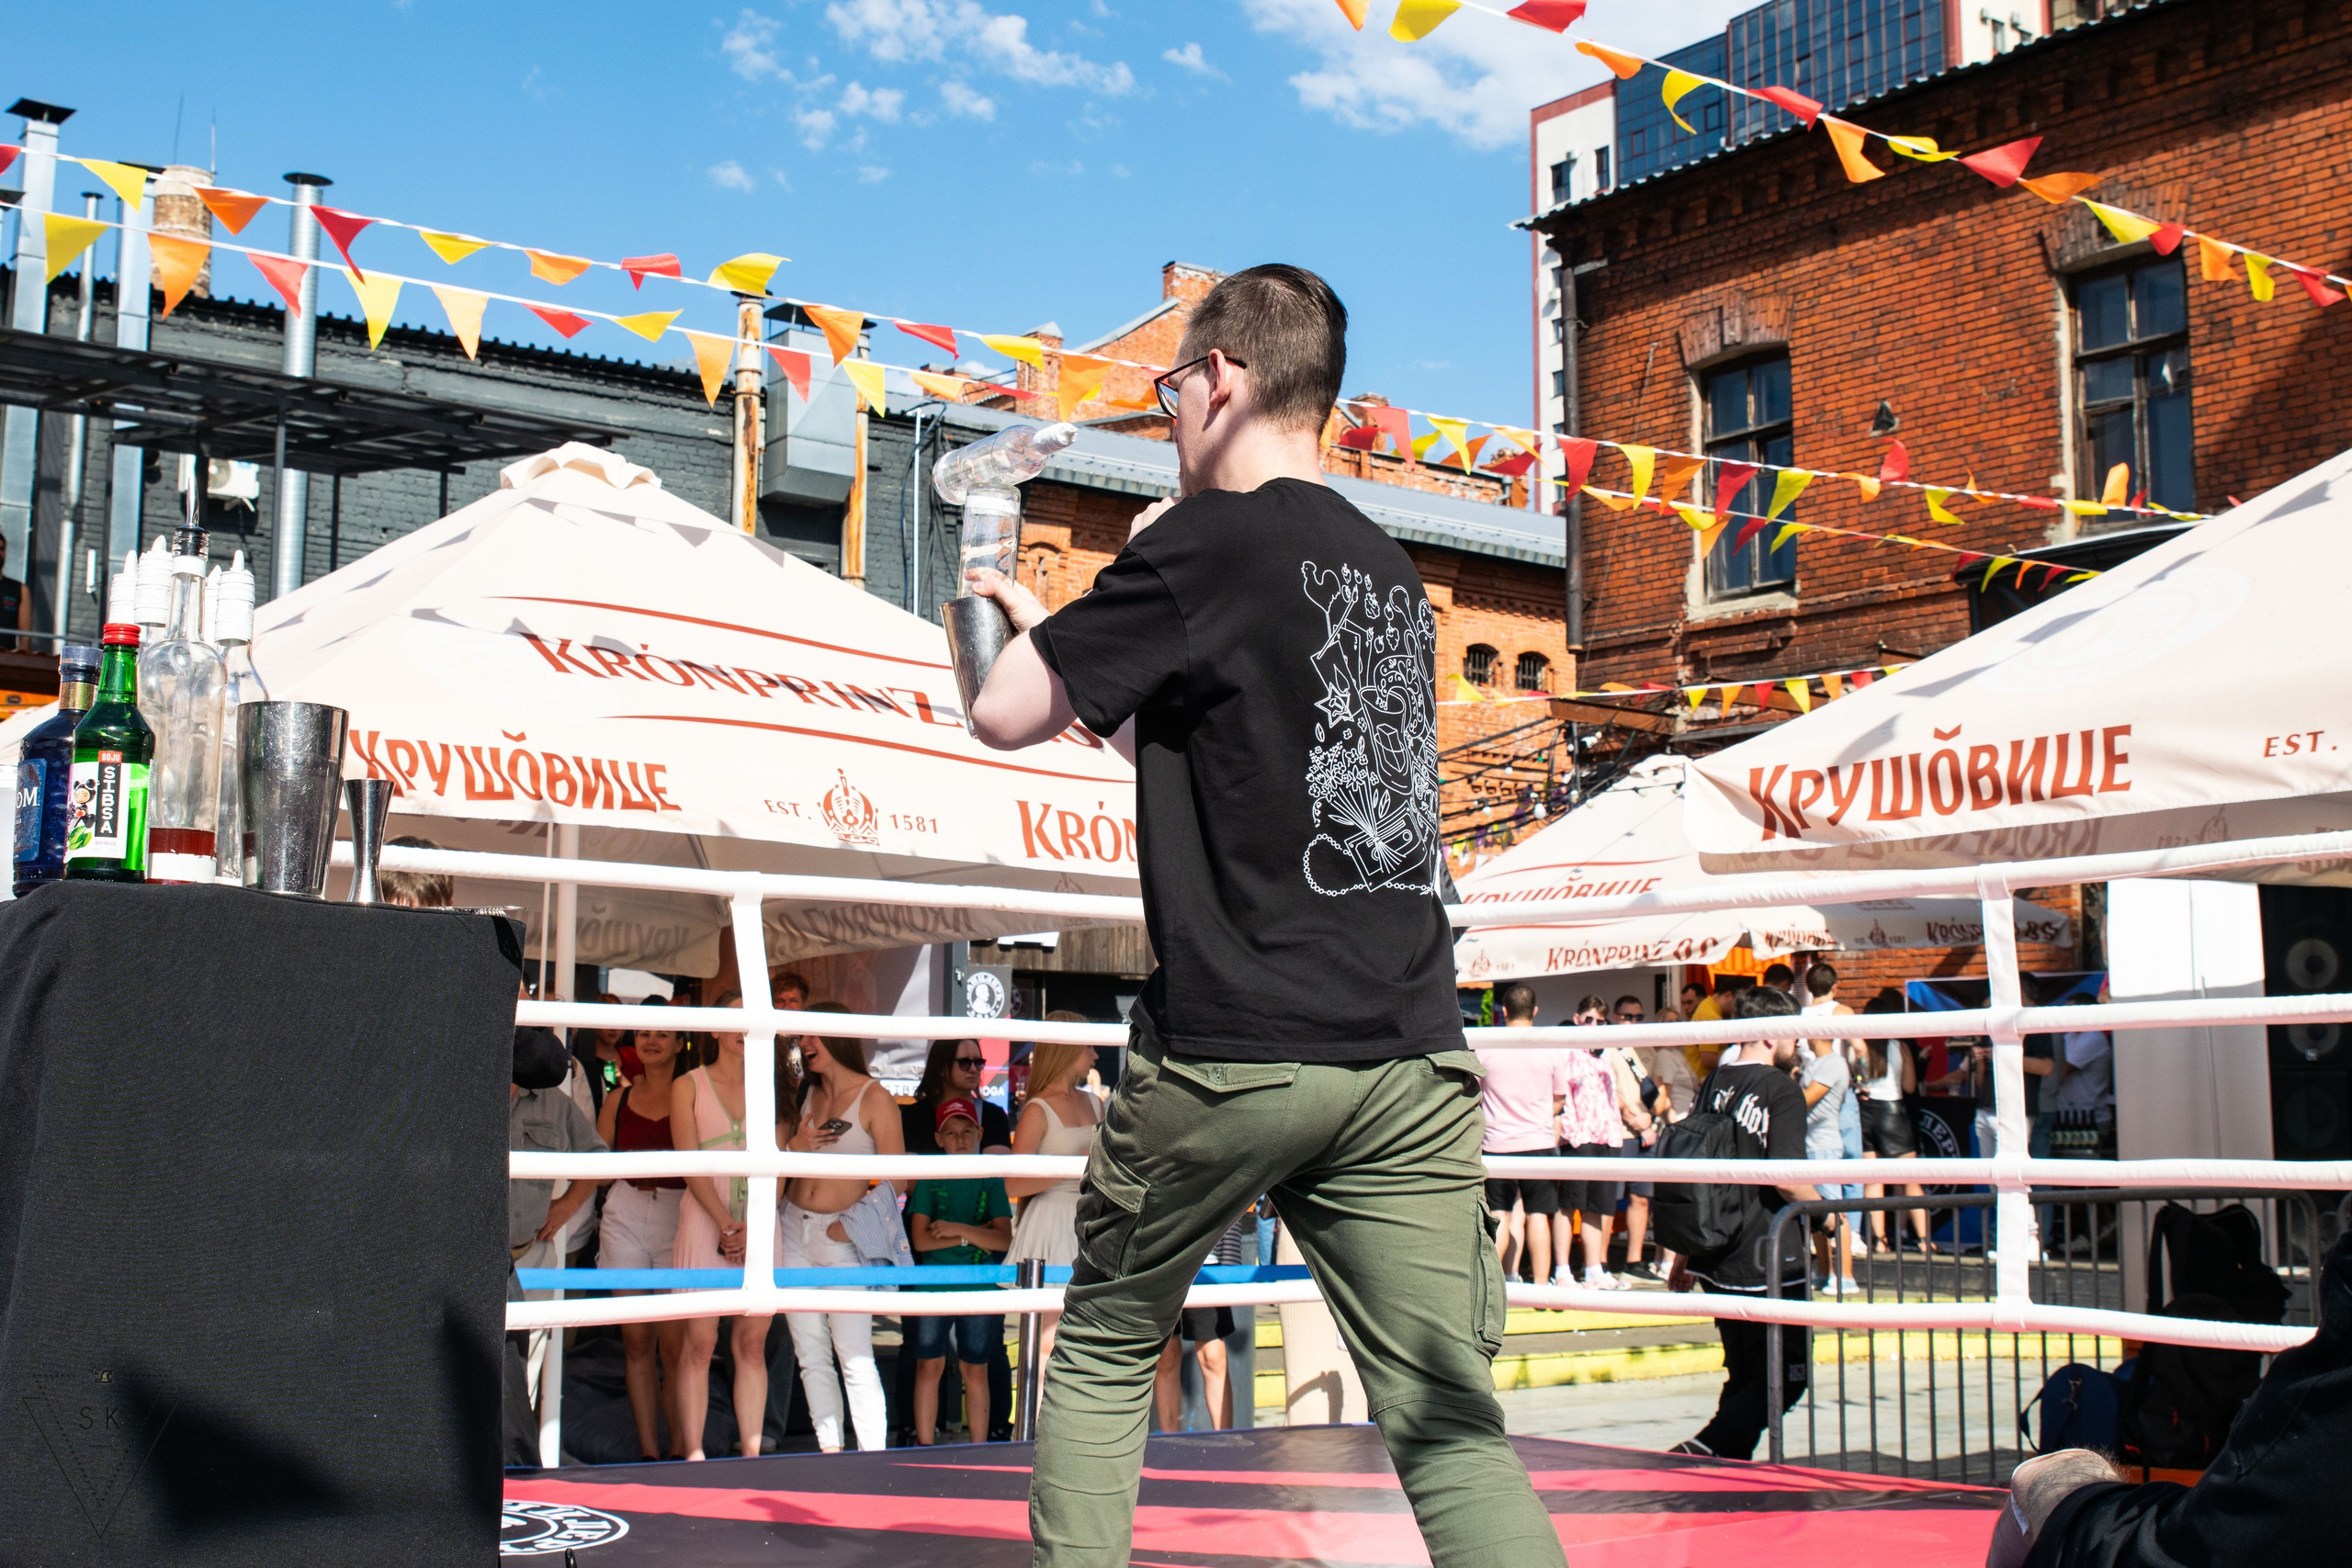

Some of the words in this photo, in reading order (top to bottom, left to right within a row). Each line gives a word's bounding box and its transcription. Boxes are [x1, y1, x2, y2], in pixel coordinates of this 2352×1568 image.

[101, 752, 120, 761] SOJU
[2263, 730, 2337, 758] EST.
[16, 785, 40, 809] OM.
[99, 765, 116, 834] SIBSA
[763, 799, 812, 820] EST.
[889, 814, 938, 834] 1581
[982, 1084, 1005, 1097] OGA
